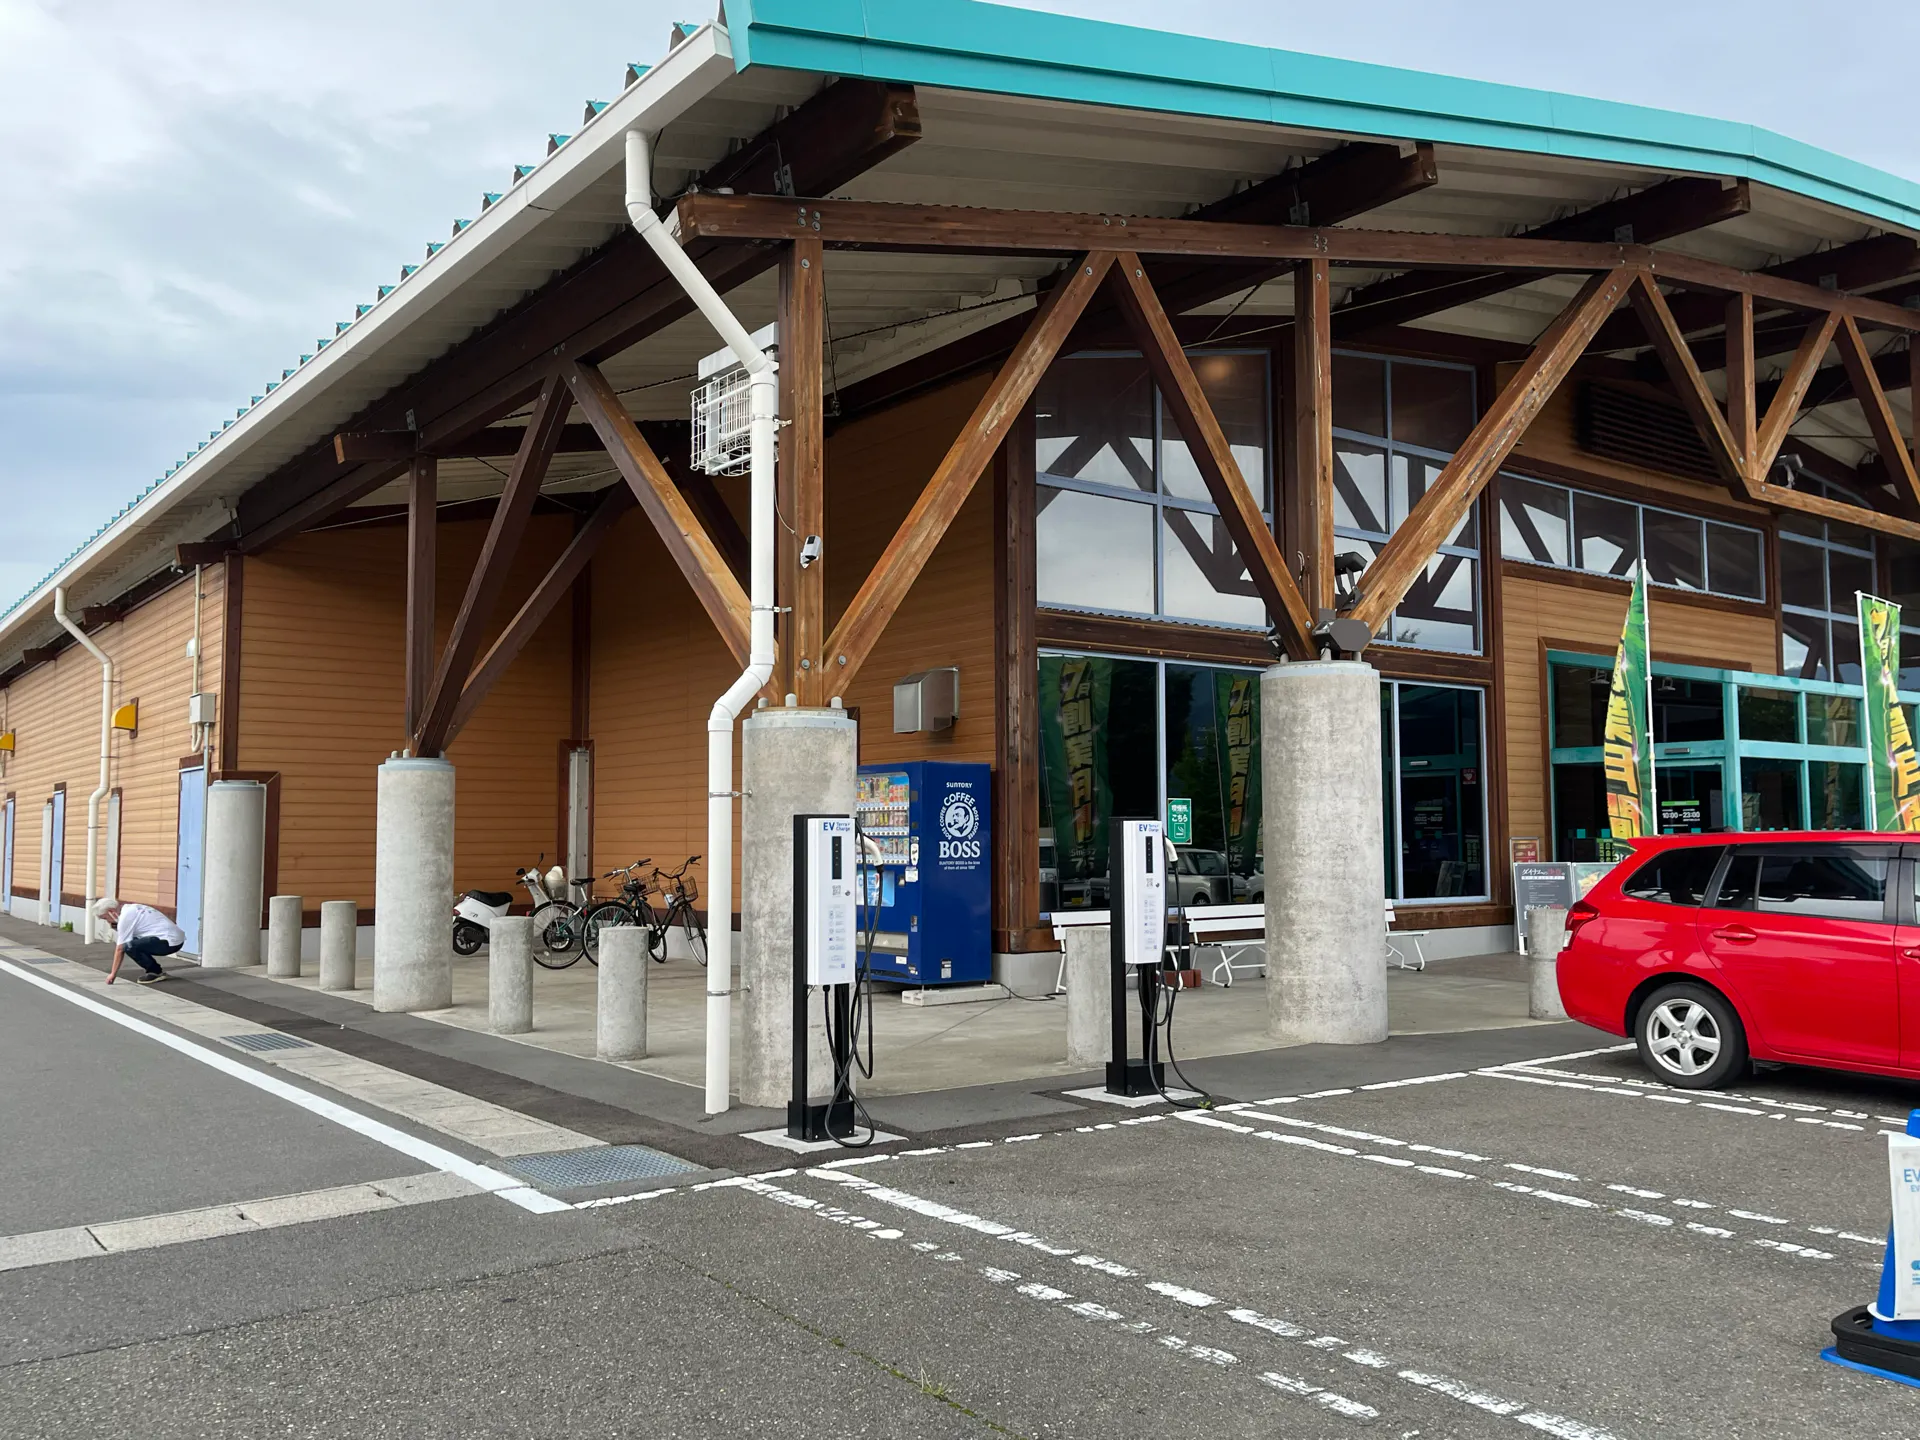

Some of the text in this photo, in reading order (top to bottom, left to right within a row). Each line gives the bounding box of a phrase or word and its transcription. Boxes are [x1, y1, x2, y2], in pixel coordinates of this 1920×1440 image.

[944, 792, 976, 807] COFFEE
[1172, 814, 1188, 822] こちら
[823, 822, 835, 831] EV
[939, 841, 980, 858] BOSS
